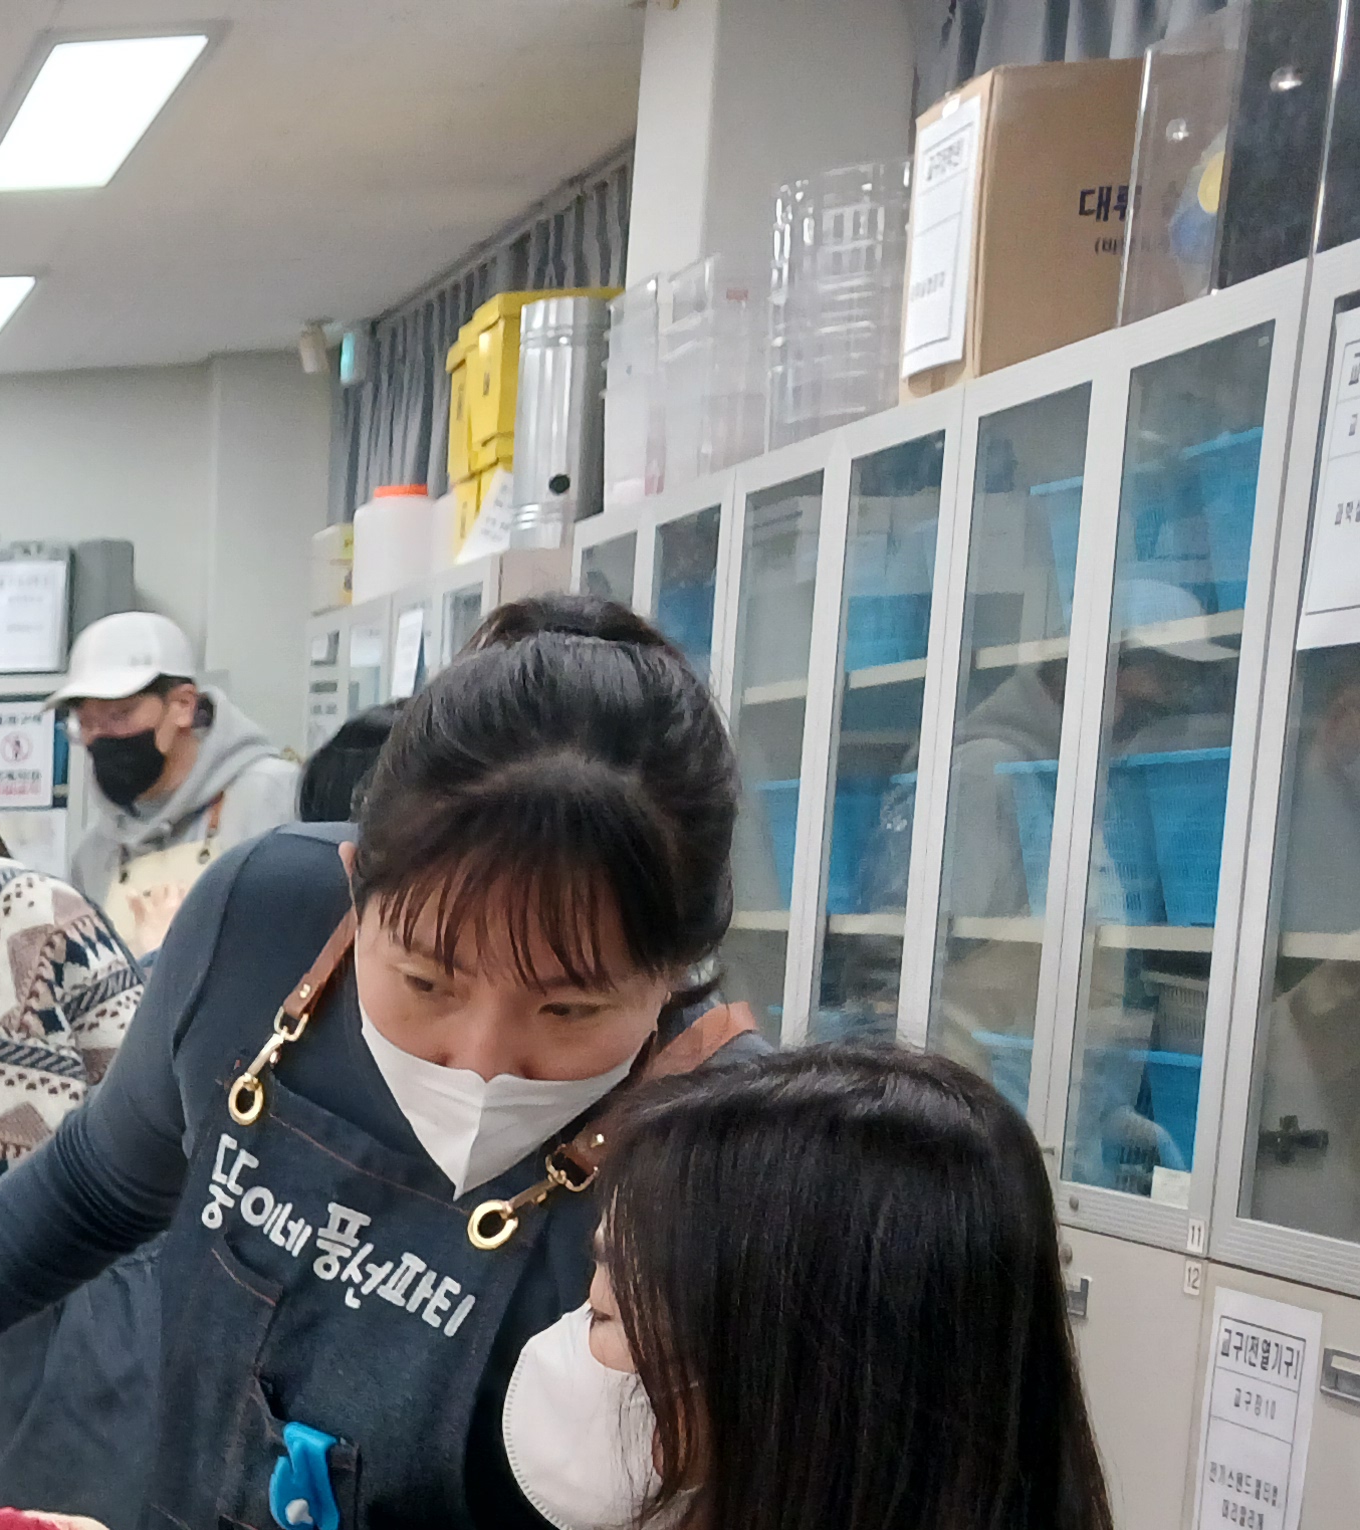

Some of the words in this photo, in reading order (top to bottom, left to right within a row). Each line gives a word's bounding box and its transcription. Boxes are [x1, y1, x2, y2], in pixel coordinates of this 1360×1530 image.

[201, 1133, 313, 1257] 뚱이네
[312, 1201, 475, 1337] 풍선파티
[1191, 1224, 1201, 1247] 11
[1187, 1266, 1200, 1290] 12
[1220, 1328, 1300, 1380] 교구(전열기구)
